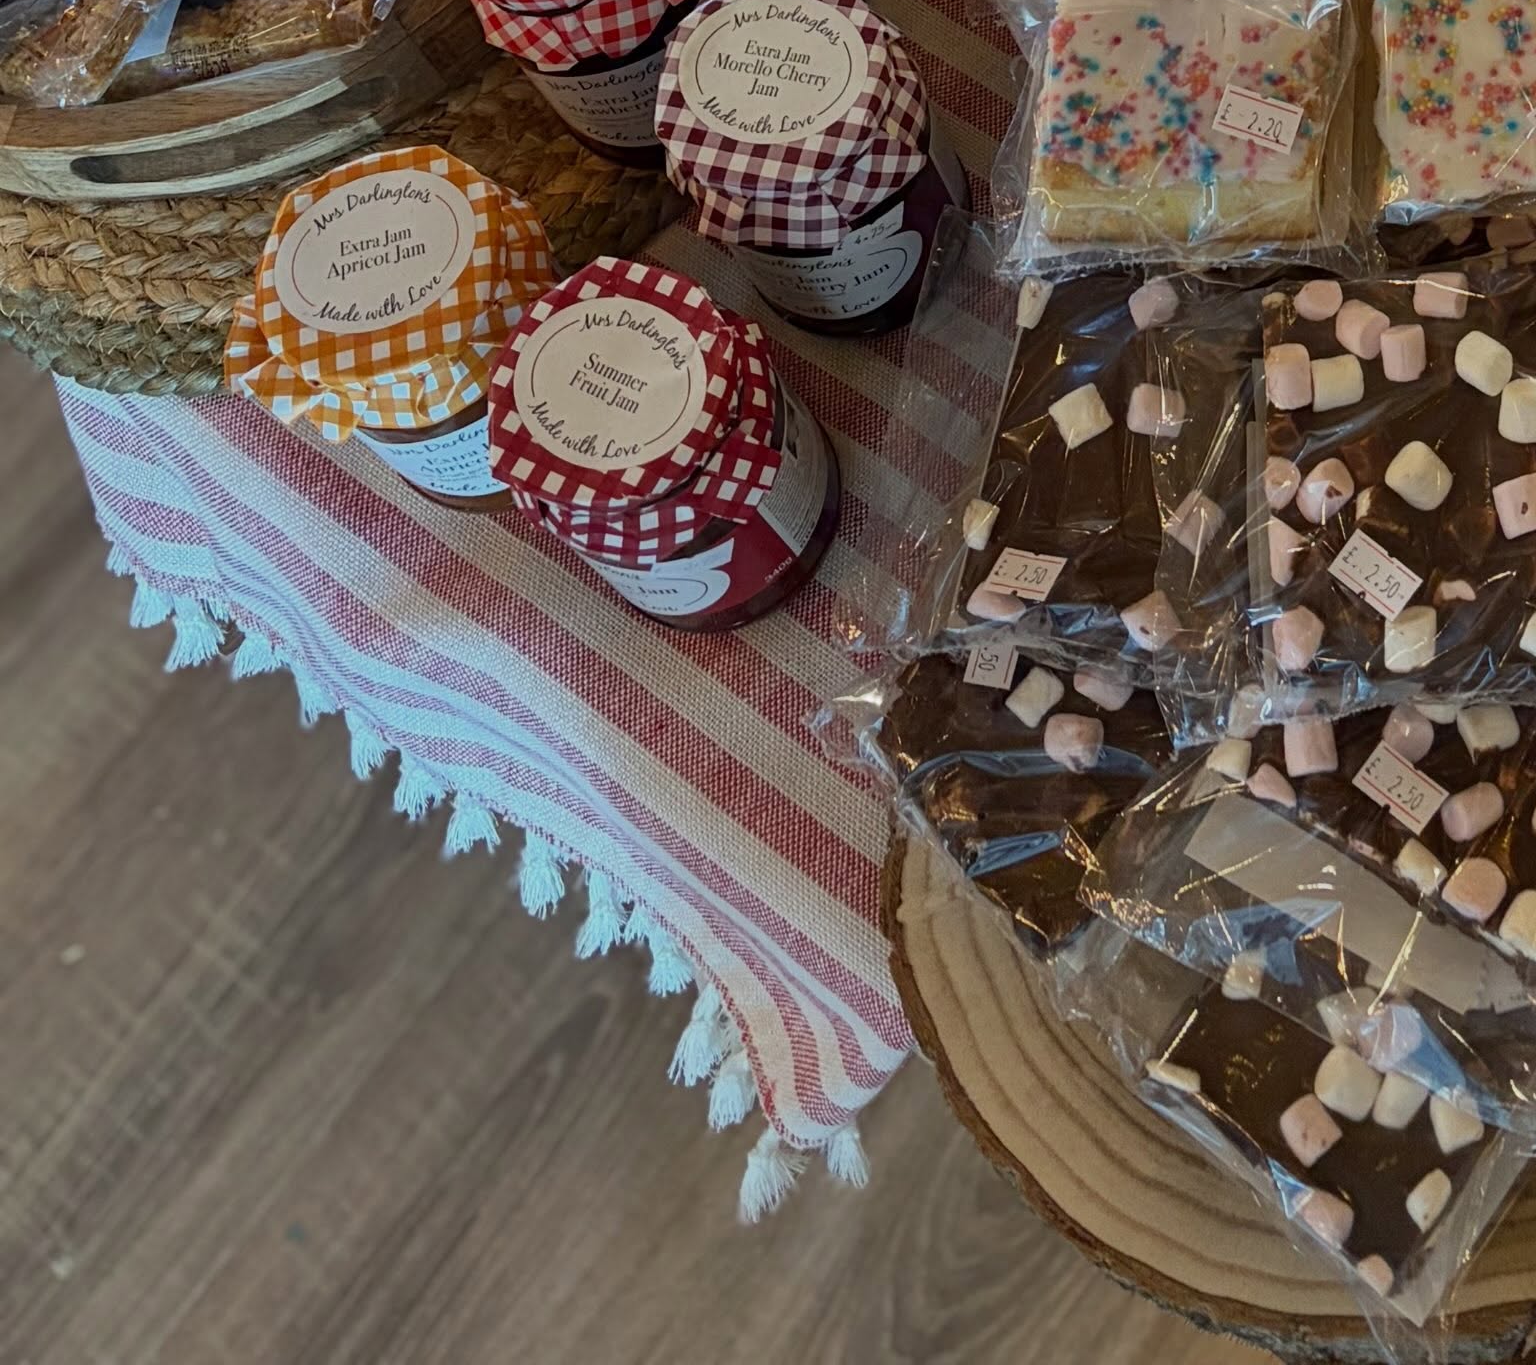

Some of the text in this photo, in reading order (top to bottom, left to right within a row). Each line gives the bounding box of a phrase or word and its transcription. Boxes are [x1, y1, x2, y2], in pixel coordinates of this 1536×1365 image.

[732, 4, 840, 46] Mrs Darlington's
[744, 39, 811, 65] Extra Jam
[713, 53, 831, 92] Morello Cherry
[747, 79, 779, 98] Jam
[698, 95, 816, 134] Made with Love
[313, 181, 431, 236] Mrs Darlington's
[326, 242, 426, 281] Apricot Jam
[340, 228, 412, 256] Extra Jam
[854, 263, 890, 286] Jam
[312, 275, 441, 322] Made with Love
[841, 296, 880, 313] Love
[579, 309, 688, 370] Mrs Darlington's
[568, 369, 640, 414] Fruit Jam
[583, 352, 649, 393] Summer
[527, 401, 641, 459] Made with Love
[638, 585, 678, 595] Jam
